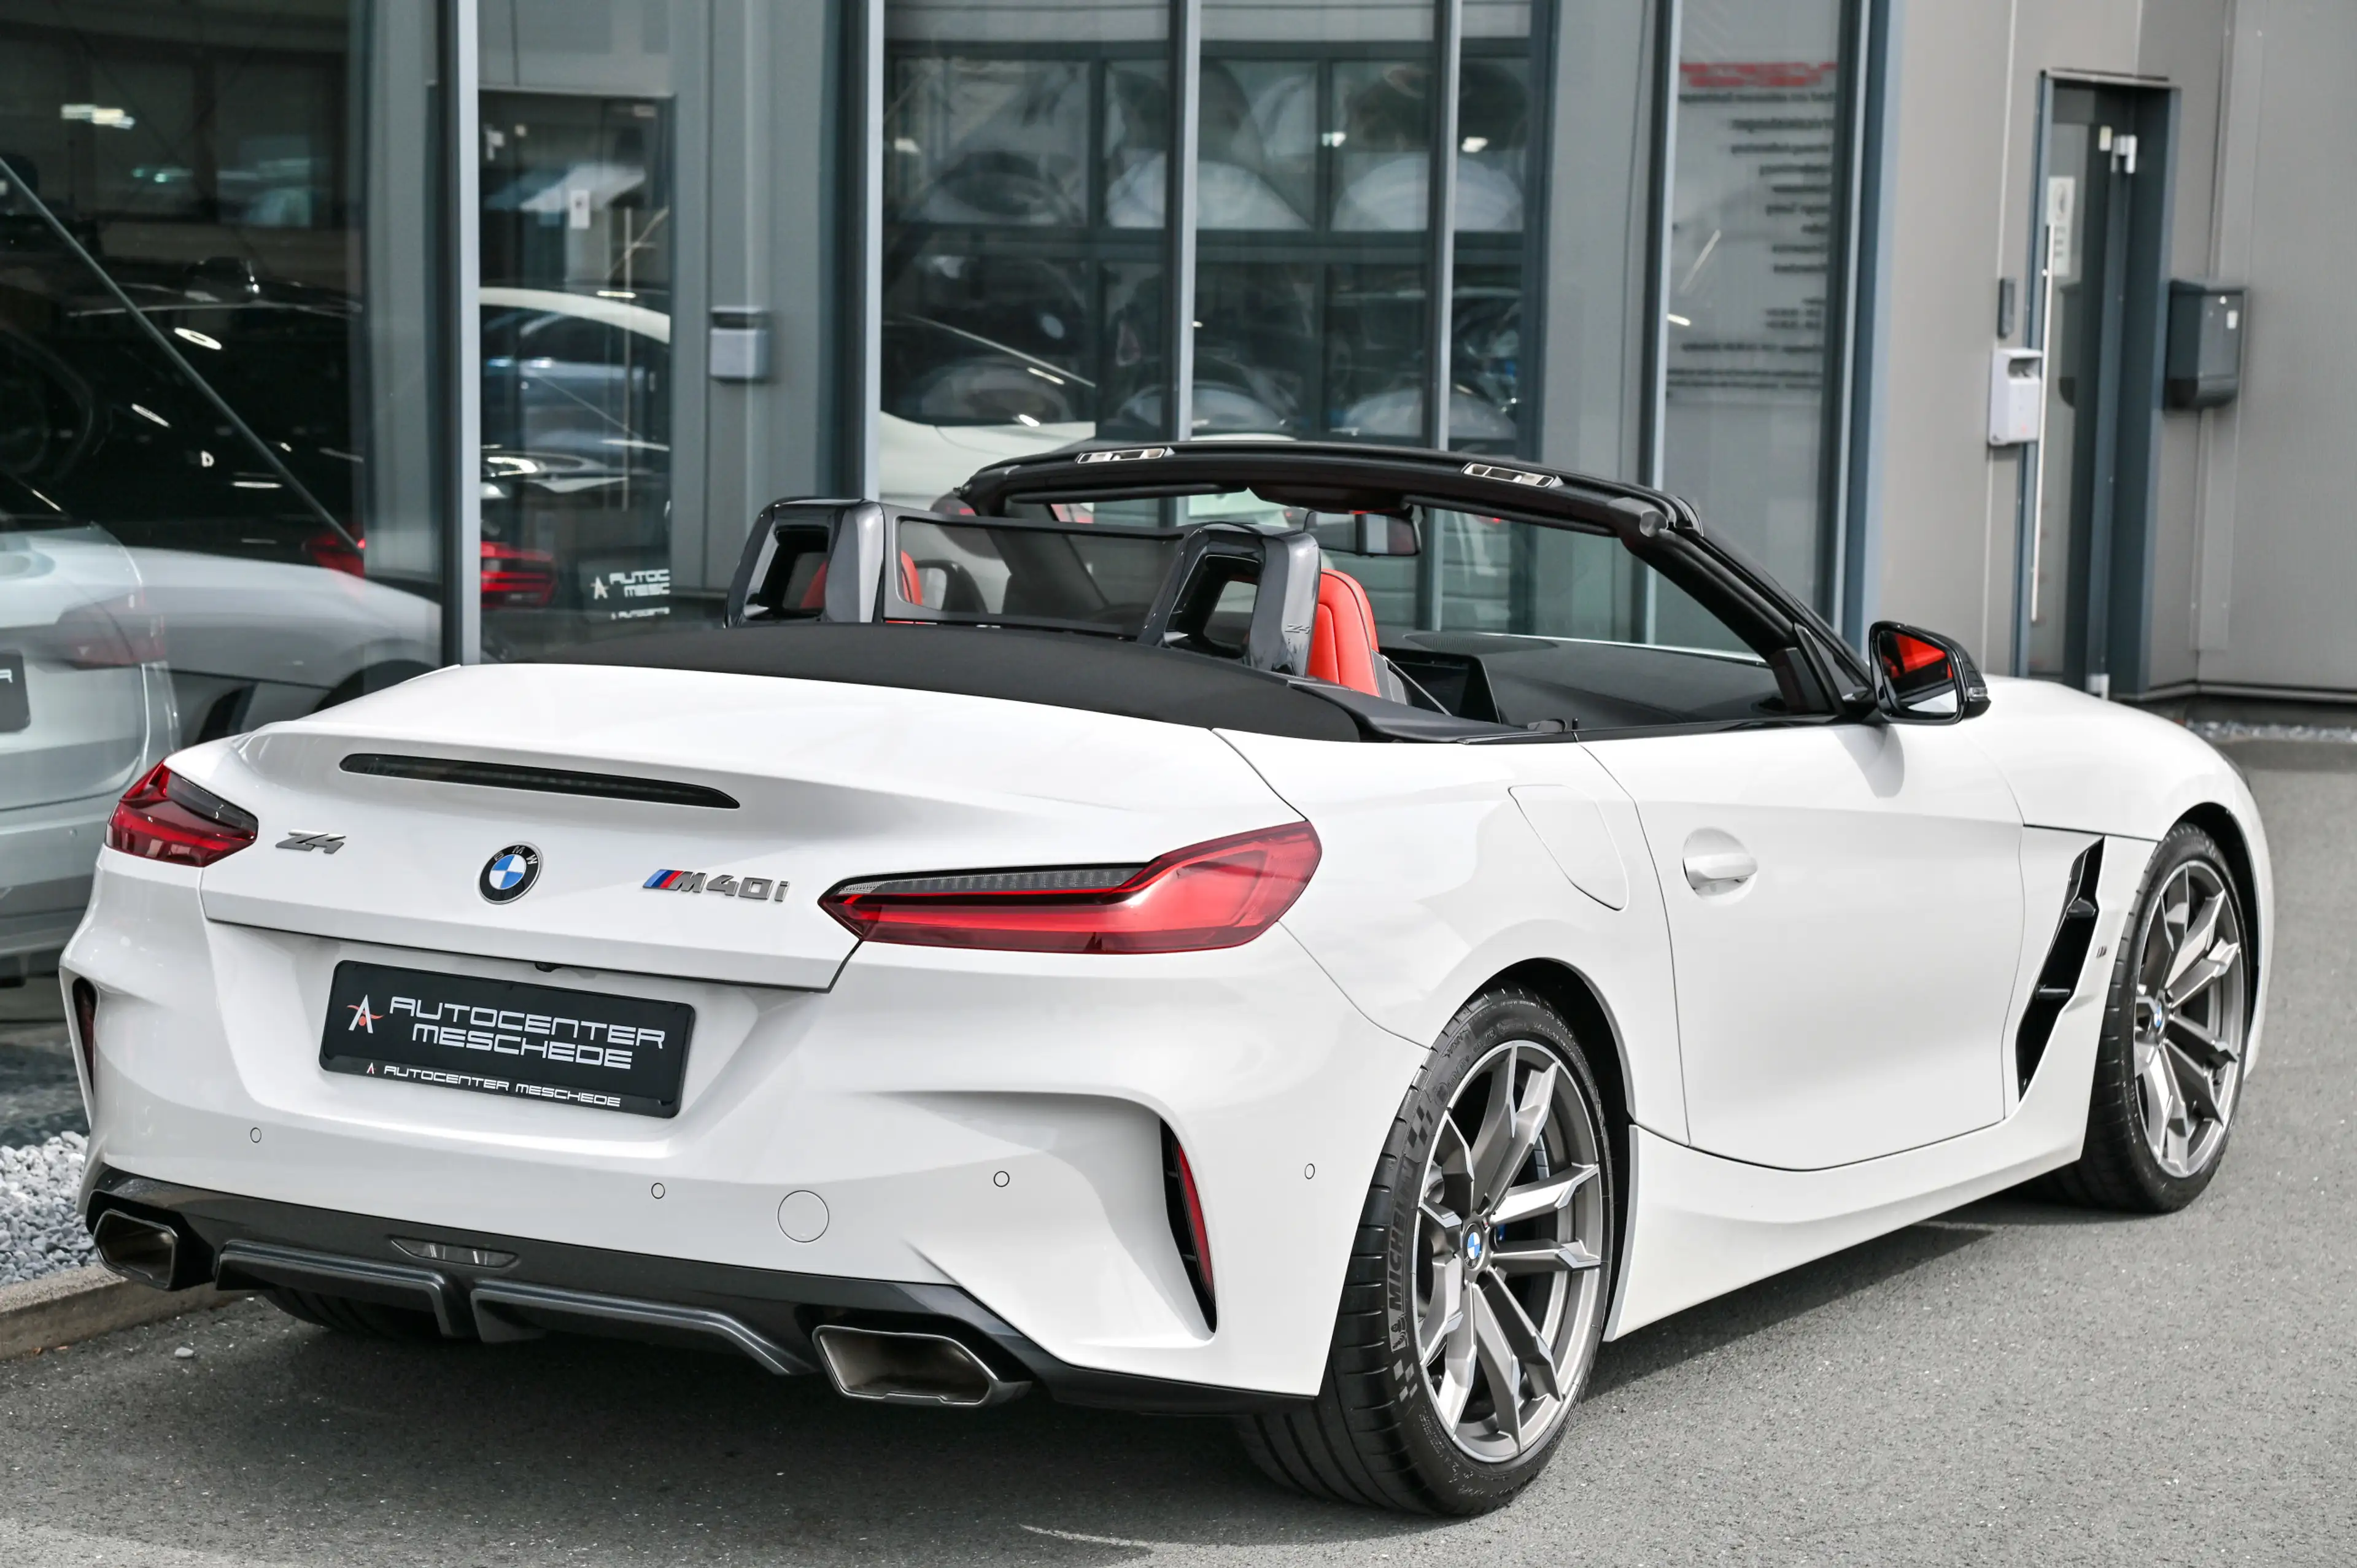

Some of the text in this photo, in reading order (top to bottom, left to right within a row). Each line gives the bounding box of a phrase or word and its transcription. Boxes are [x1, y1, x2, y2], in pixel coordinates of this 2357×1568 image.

[610, 569, 670, 584] AUTOC
[624, 582, 670, 597] MESC
[275, 829, 347, 854] Z4
[390, 996, 665, 1049] AUTOCENTER
[412, 1023, 633, 1069] MESCHEDE
[384, 1065, 621, 1108] AUTOCENTER MESCHEDE
